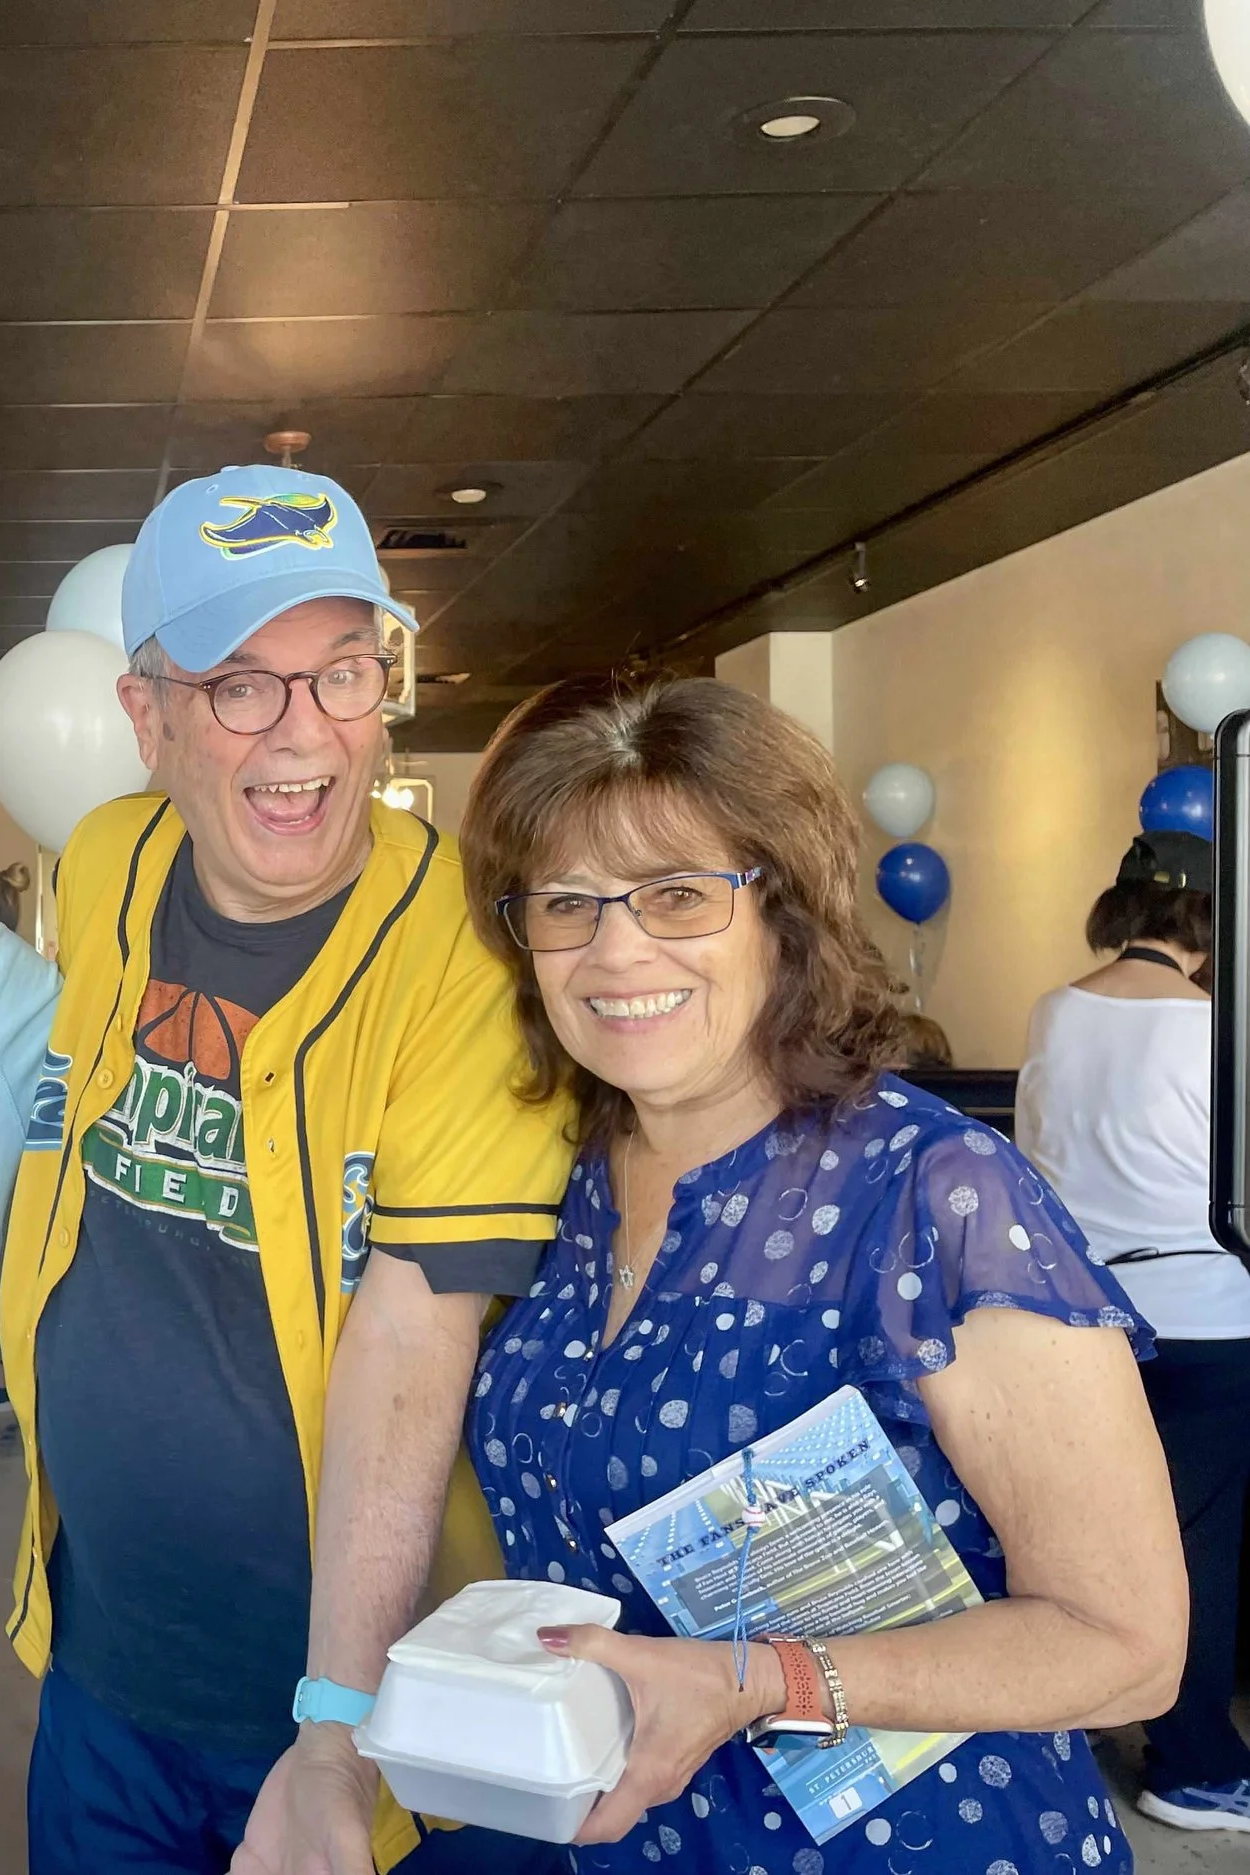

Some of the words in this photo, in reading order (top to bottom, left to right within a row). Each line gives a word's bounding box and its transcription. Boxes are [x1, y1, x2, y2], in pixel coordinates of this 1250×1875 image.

[114, 1153, 240, 1218] FIED
[656, 1544, 694, 1567] THE
[699, 1517, 746, 1547] FANS
[763, 1487, 801, 1514] AVE
[804, 1439, 872, 1490] SPOKEN
[840, 1794, 852, 1811] 1
